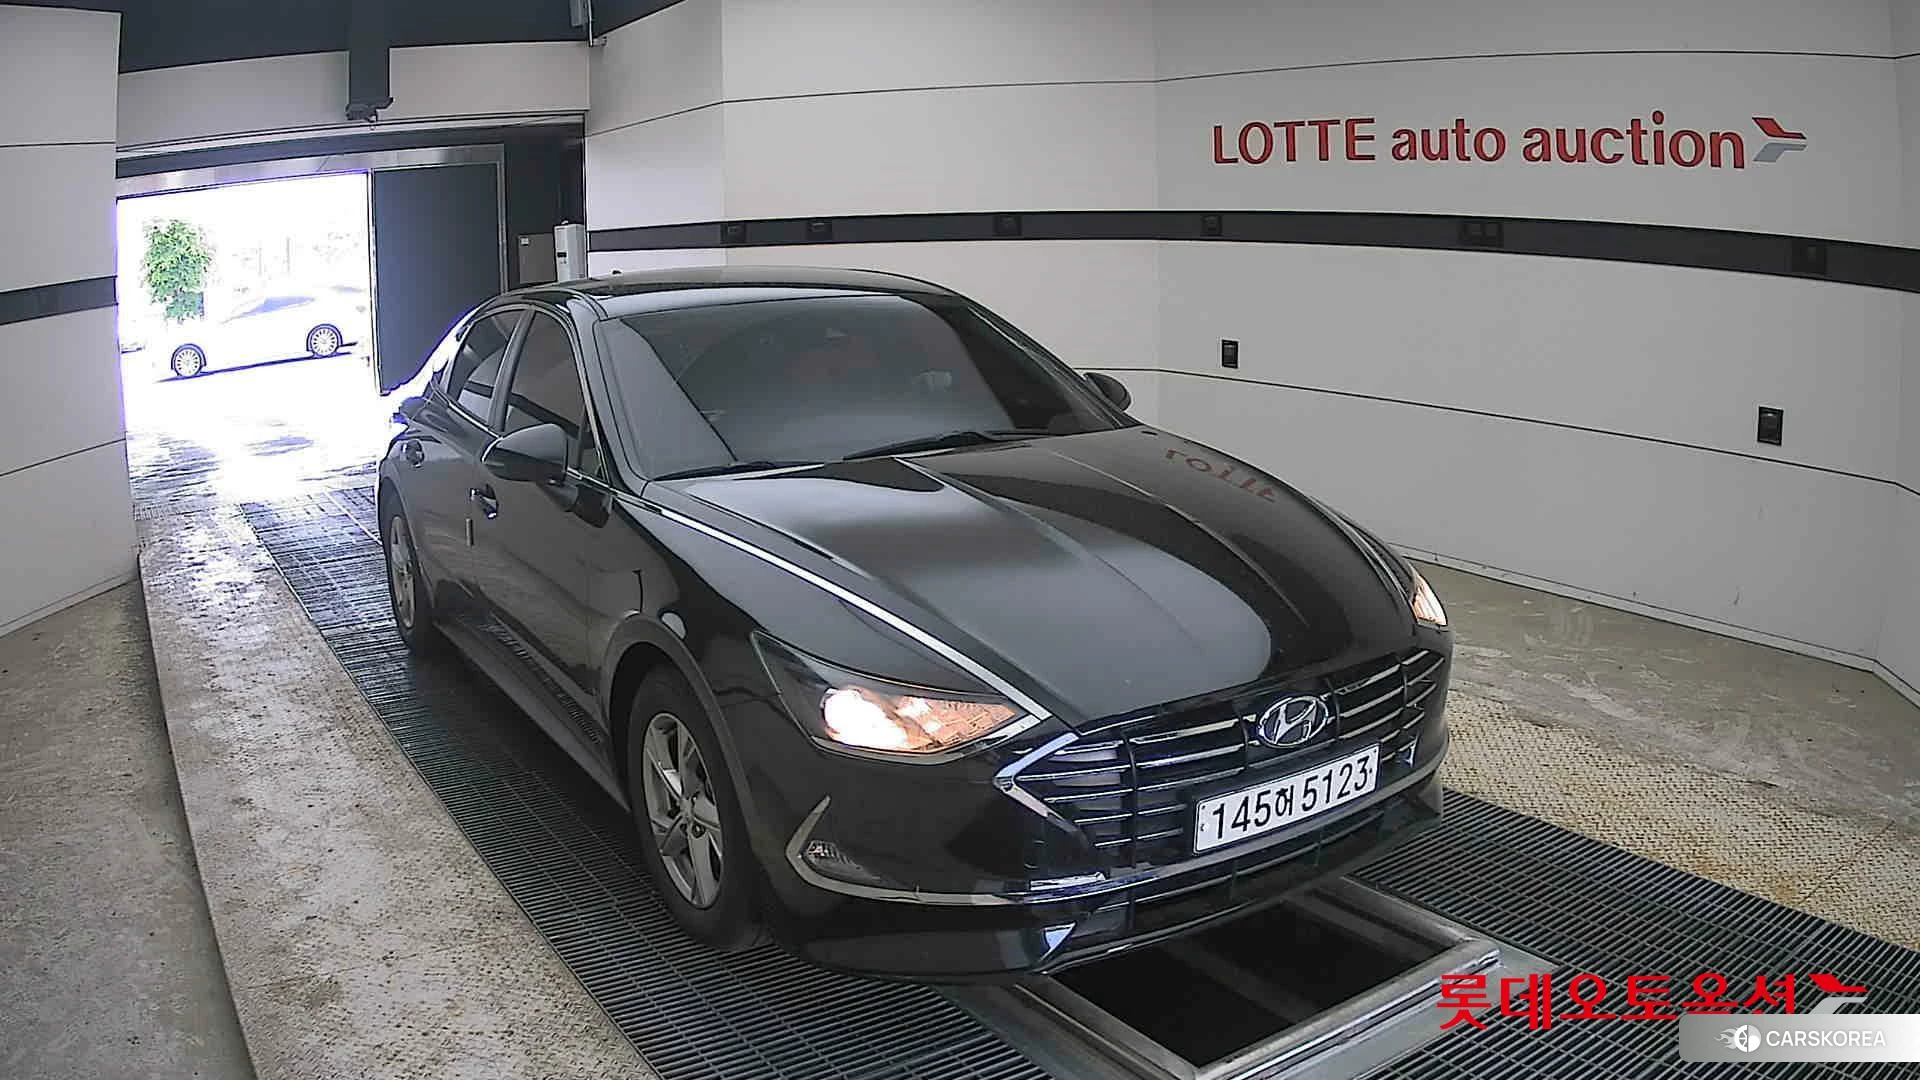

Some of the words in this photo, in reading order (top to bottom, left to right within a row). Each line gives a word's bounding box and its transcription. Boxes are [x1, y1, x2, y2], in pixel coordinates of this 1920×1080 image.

[1212, 117, 1377, 165] LOTTE
[1390, 117, 1507, 162] auto
[1521, 109, 1747, 170] auction
[1212, 784, 1294, 840] 145허
[1302, 756, 1371, 812] 5123
